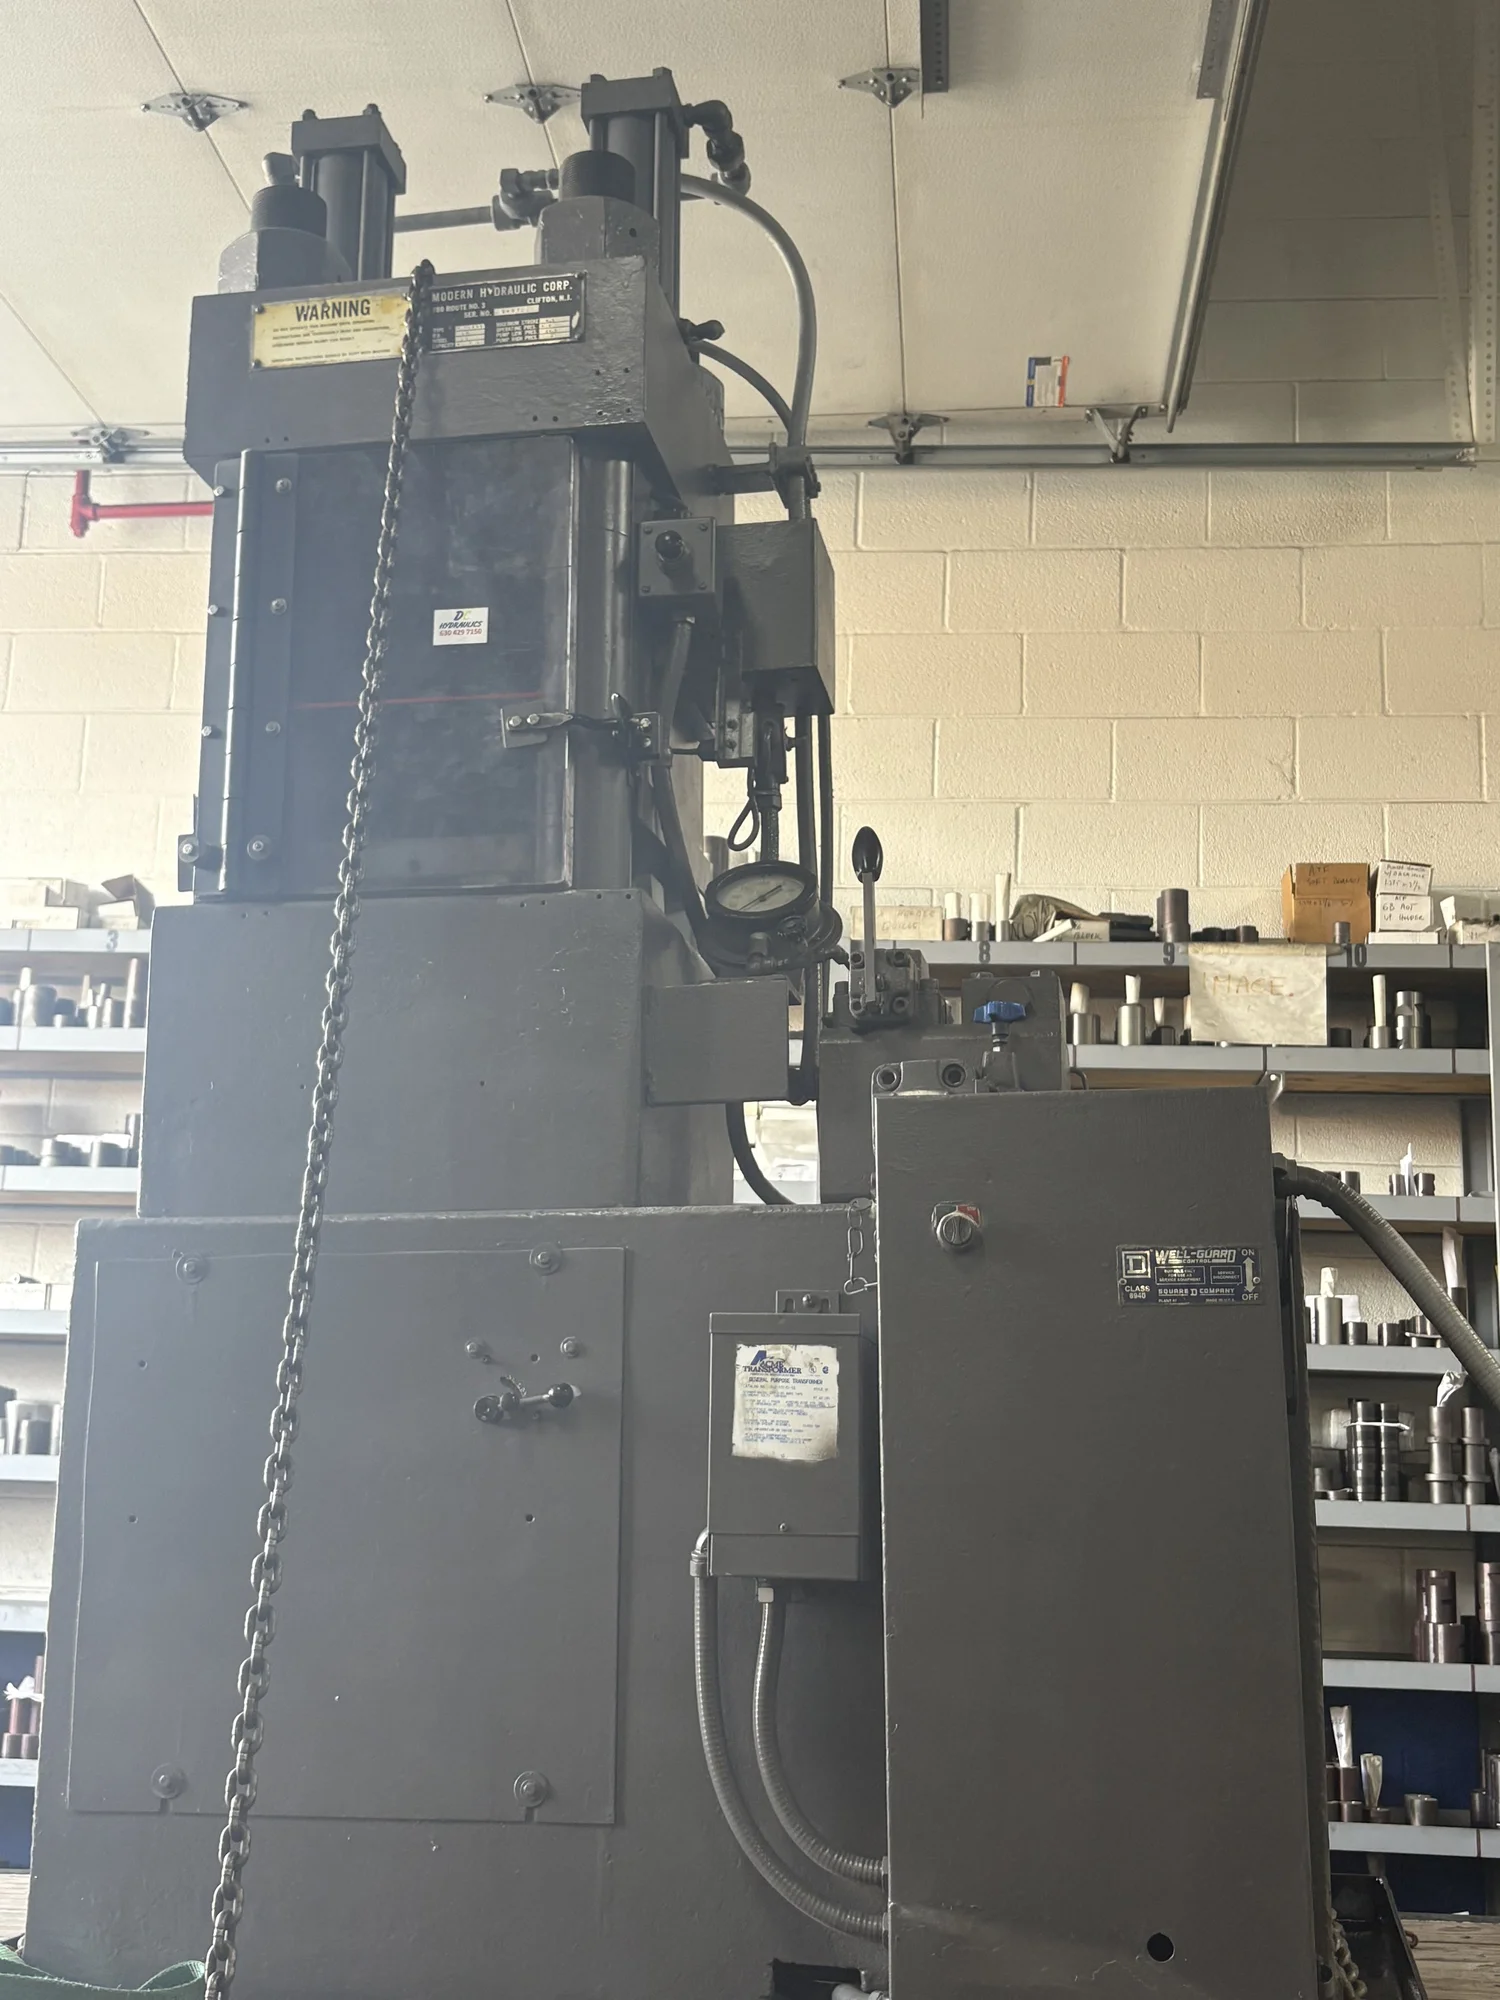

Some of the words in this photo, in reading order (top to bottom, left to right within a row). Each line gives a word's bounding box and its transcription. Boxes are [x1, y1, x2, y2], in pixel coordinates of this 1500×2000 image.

[432, 289, 473, 302] MODERN
[480, 283, 536, 298] HYDRAULIC
[543, 280, 572, 292] CORP.
[296, 299, 371, 322] WARNING
[439, 621, 483, 629] HYDRAULICS
[106, 930, 118, 952] 3
[979, 941, 990, 964] 8
[1163, 942, 1175, 965] 9
[1345, 944, 1367, 967] 10
[1155, 1249, 1236, 1264] WELL-GUARD
[1190, 1288, 1198, 1296] D
[1242, 1293, 1259, 1301] OFF
[743, 1365, 802, 1374] TRANSFORMER
